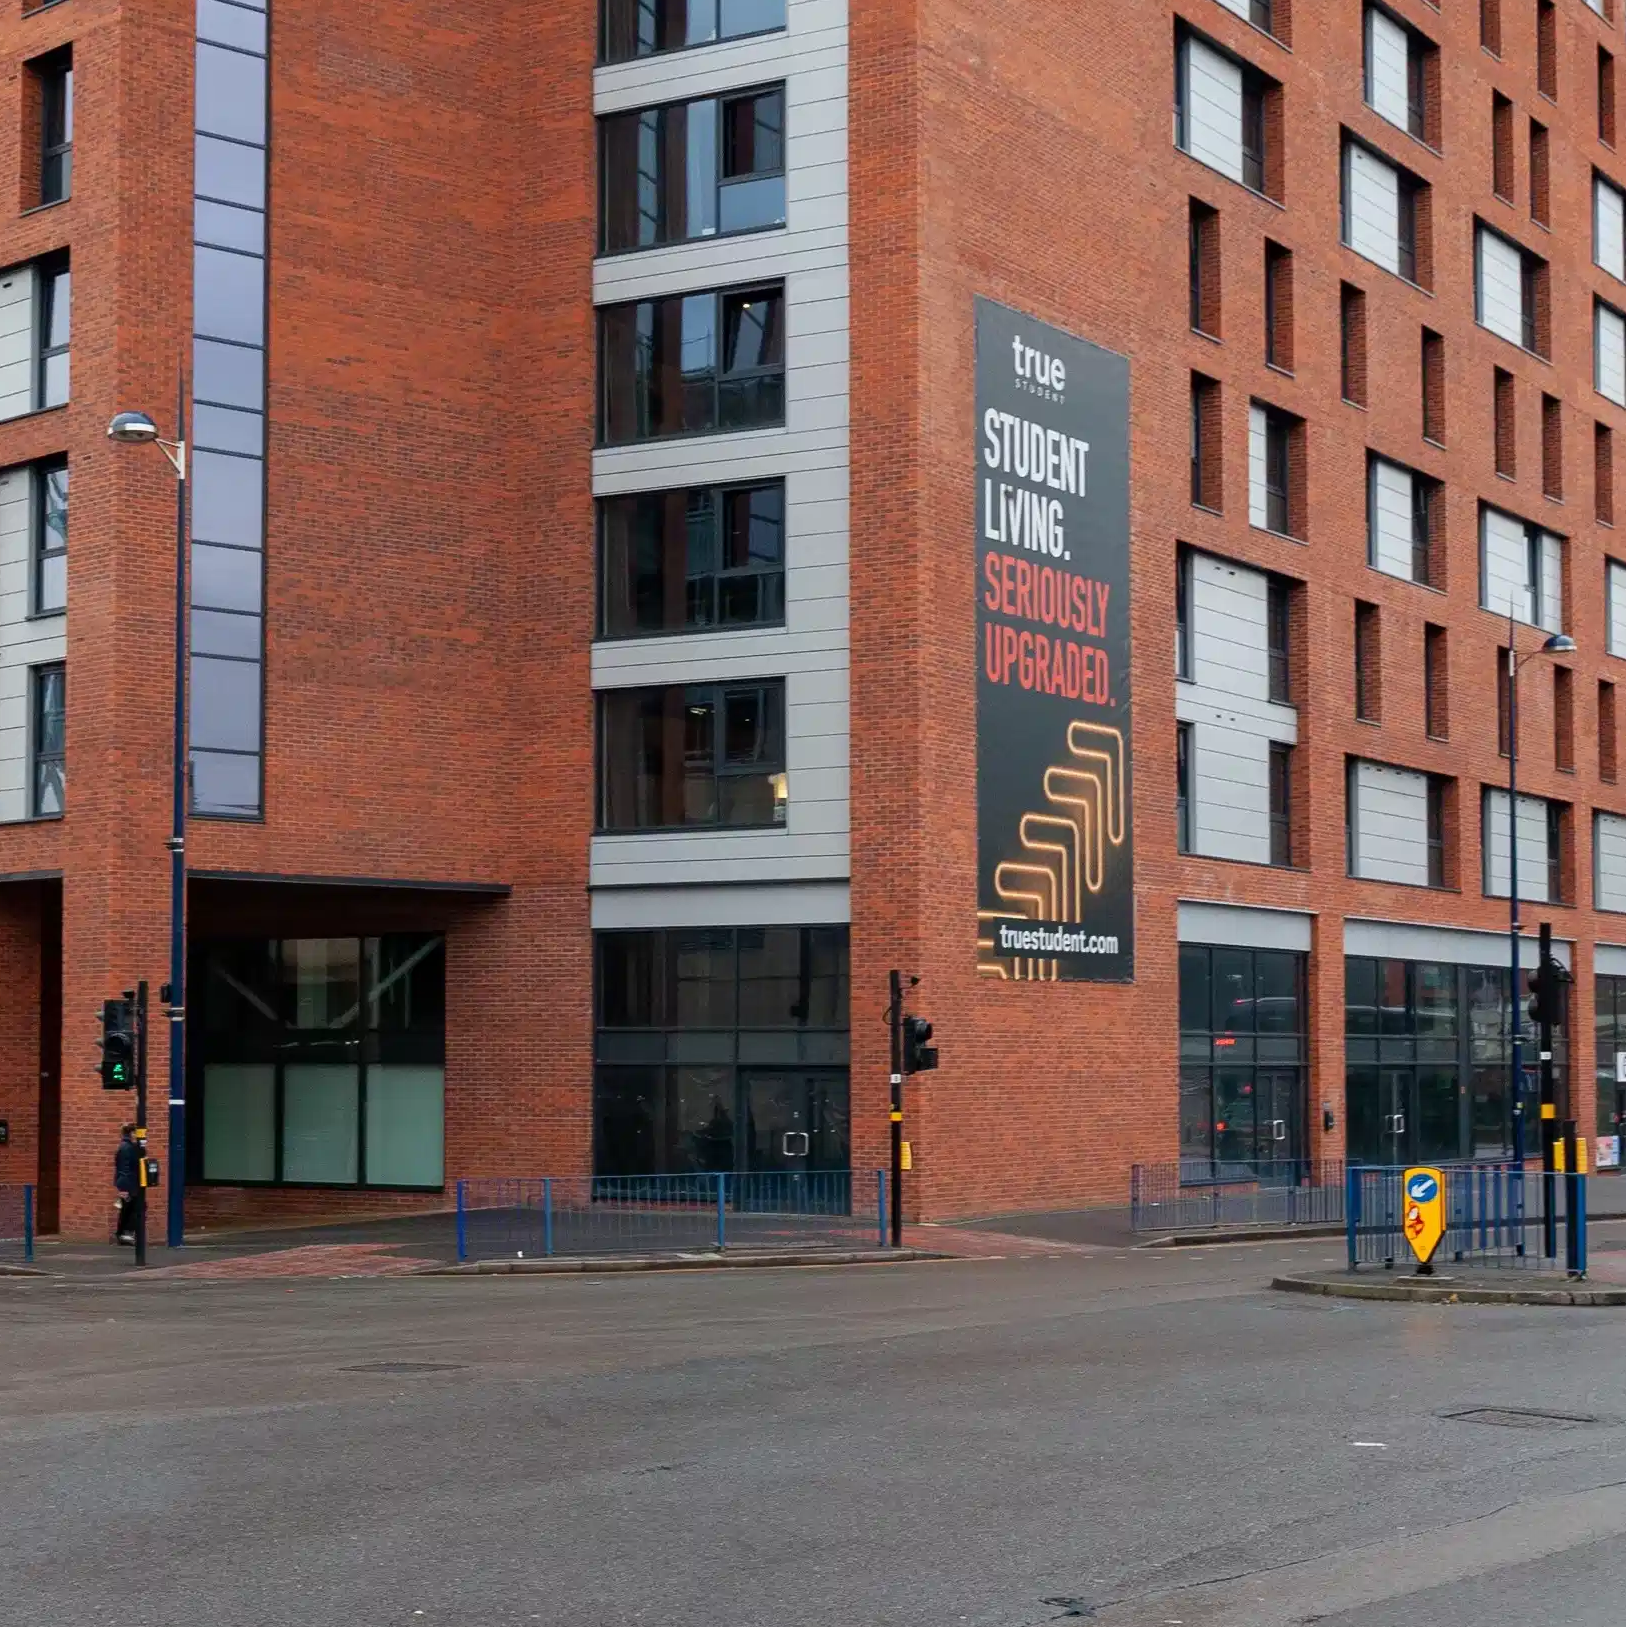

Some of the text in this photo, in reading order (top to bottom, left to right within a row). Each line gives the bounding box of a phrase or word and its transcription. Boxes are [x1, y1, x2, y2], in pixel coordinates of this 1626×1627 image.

[1012, 334, 1066, 391] true
[1014, 378, 1066, 405] STUDENT
[983, 407, 1089, 498] STUDENT
[983, 478, 1071, 561] LIVING.
[984, 551, 1109, 638] SERIOUSLY
[984, 622, 1116, 708] UPGRADED.
[999, 924, 1119, 954] truestudent.com
